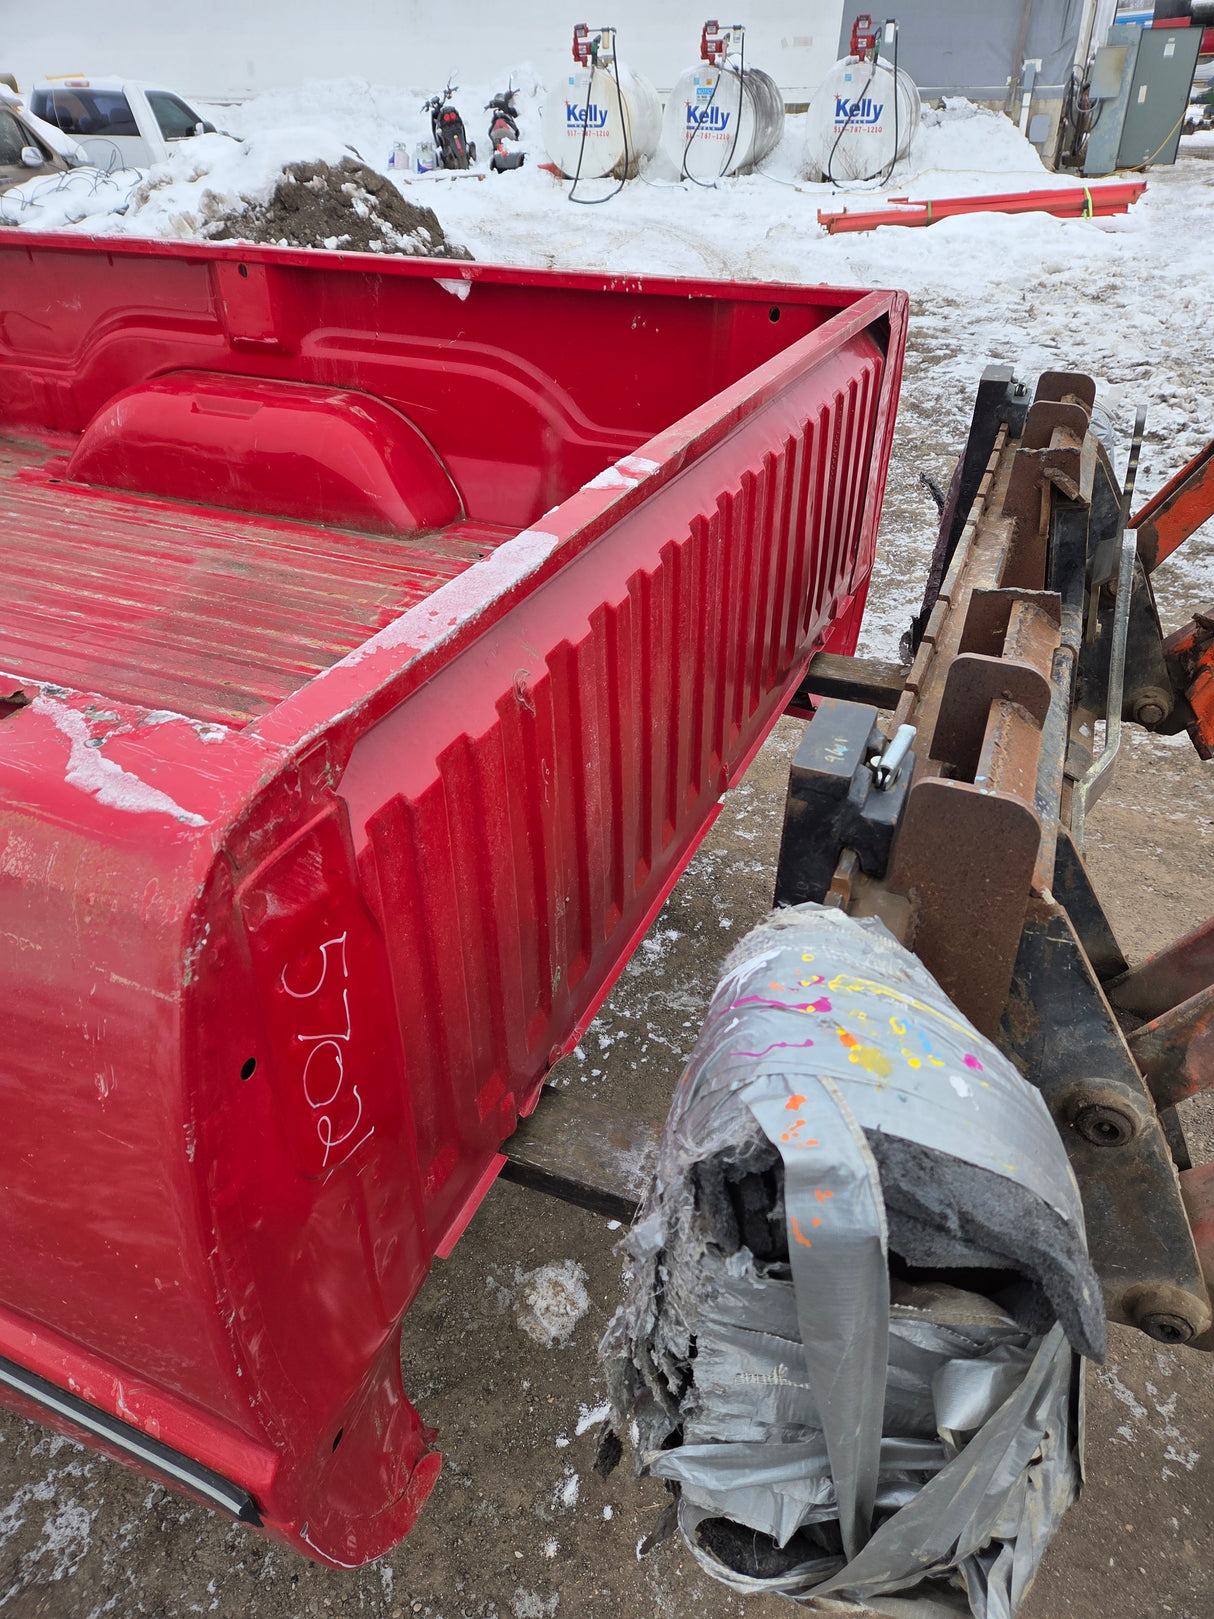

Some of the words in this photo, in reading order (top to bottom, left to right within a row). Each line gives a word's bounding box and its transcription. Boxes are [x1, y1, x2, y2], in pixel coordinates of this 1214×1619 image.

[566, 104, 608, 128] Kelly
[686, 105, 730, 131] Kelly
[835, 98, 884, 124] Kelly
